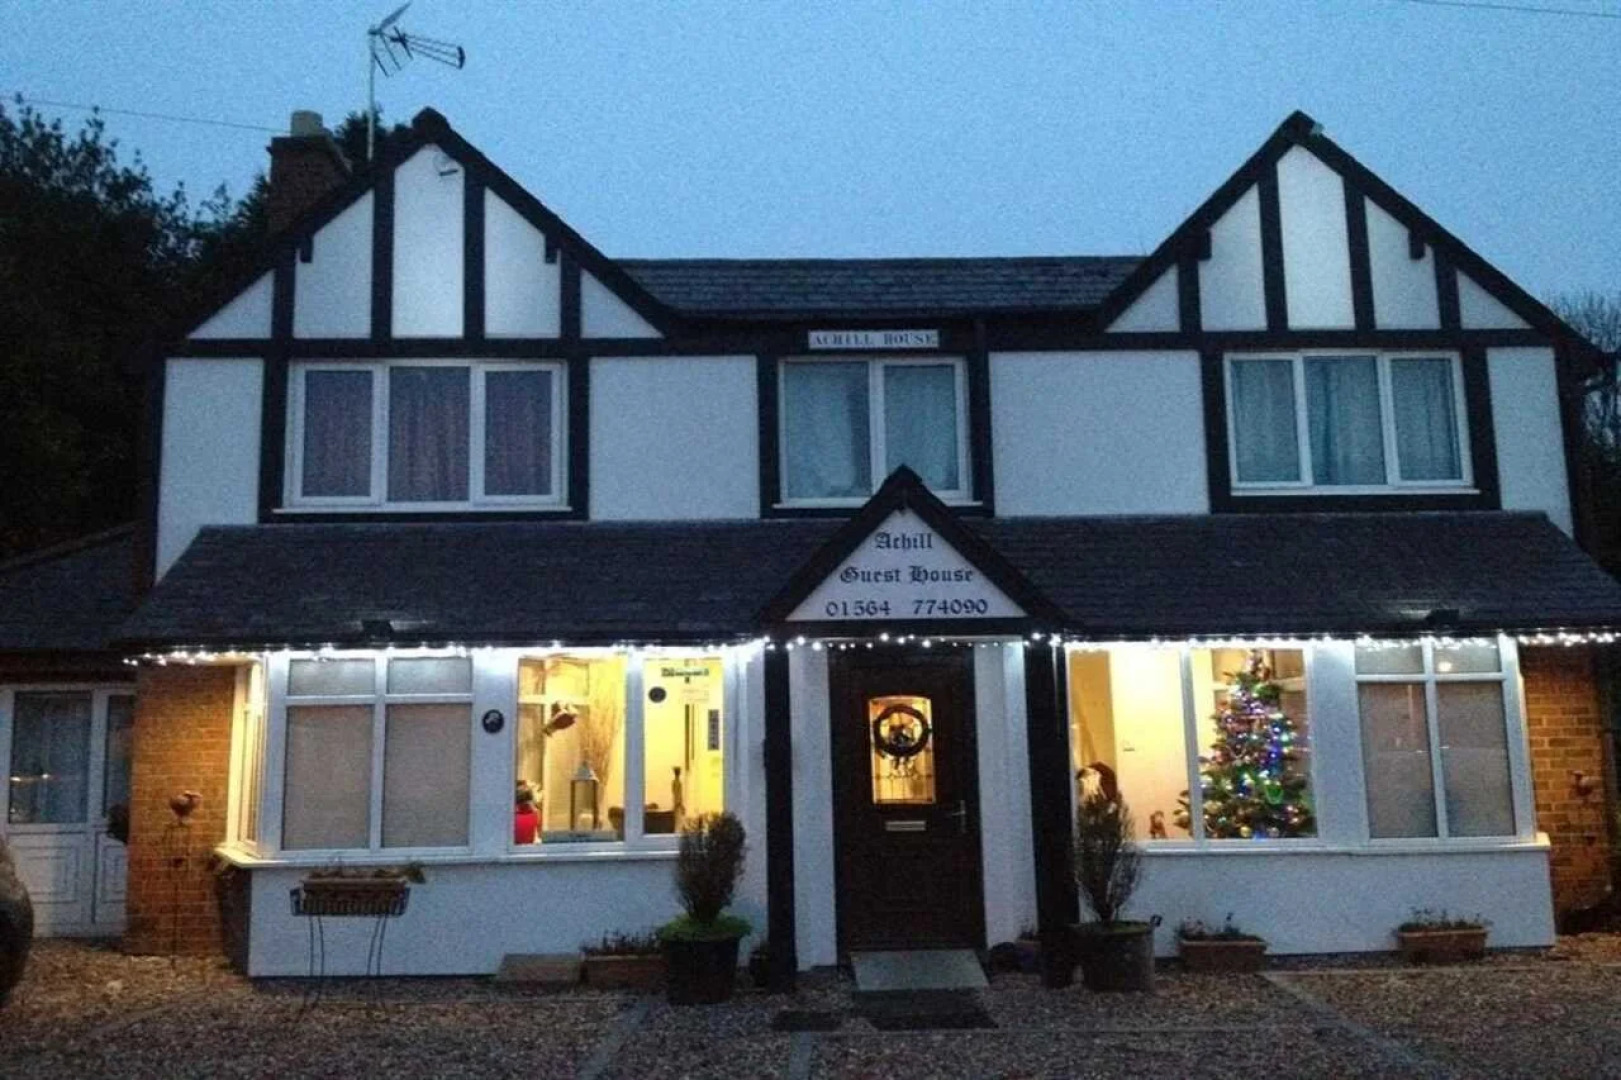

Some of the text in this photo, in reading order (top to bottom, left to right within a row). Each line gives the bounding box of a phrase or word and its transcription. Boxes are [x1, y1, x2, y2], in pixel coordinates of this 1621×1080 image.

[883, 332, 936, 345] HOUSE
[875, 531, 933, 550] Achill
[840, 565, 974, 585] Guest House
[825, 598, 989, 618] 01564 774090
